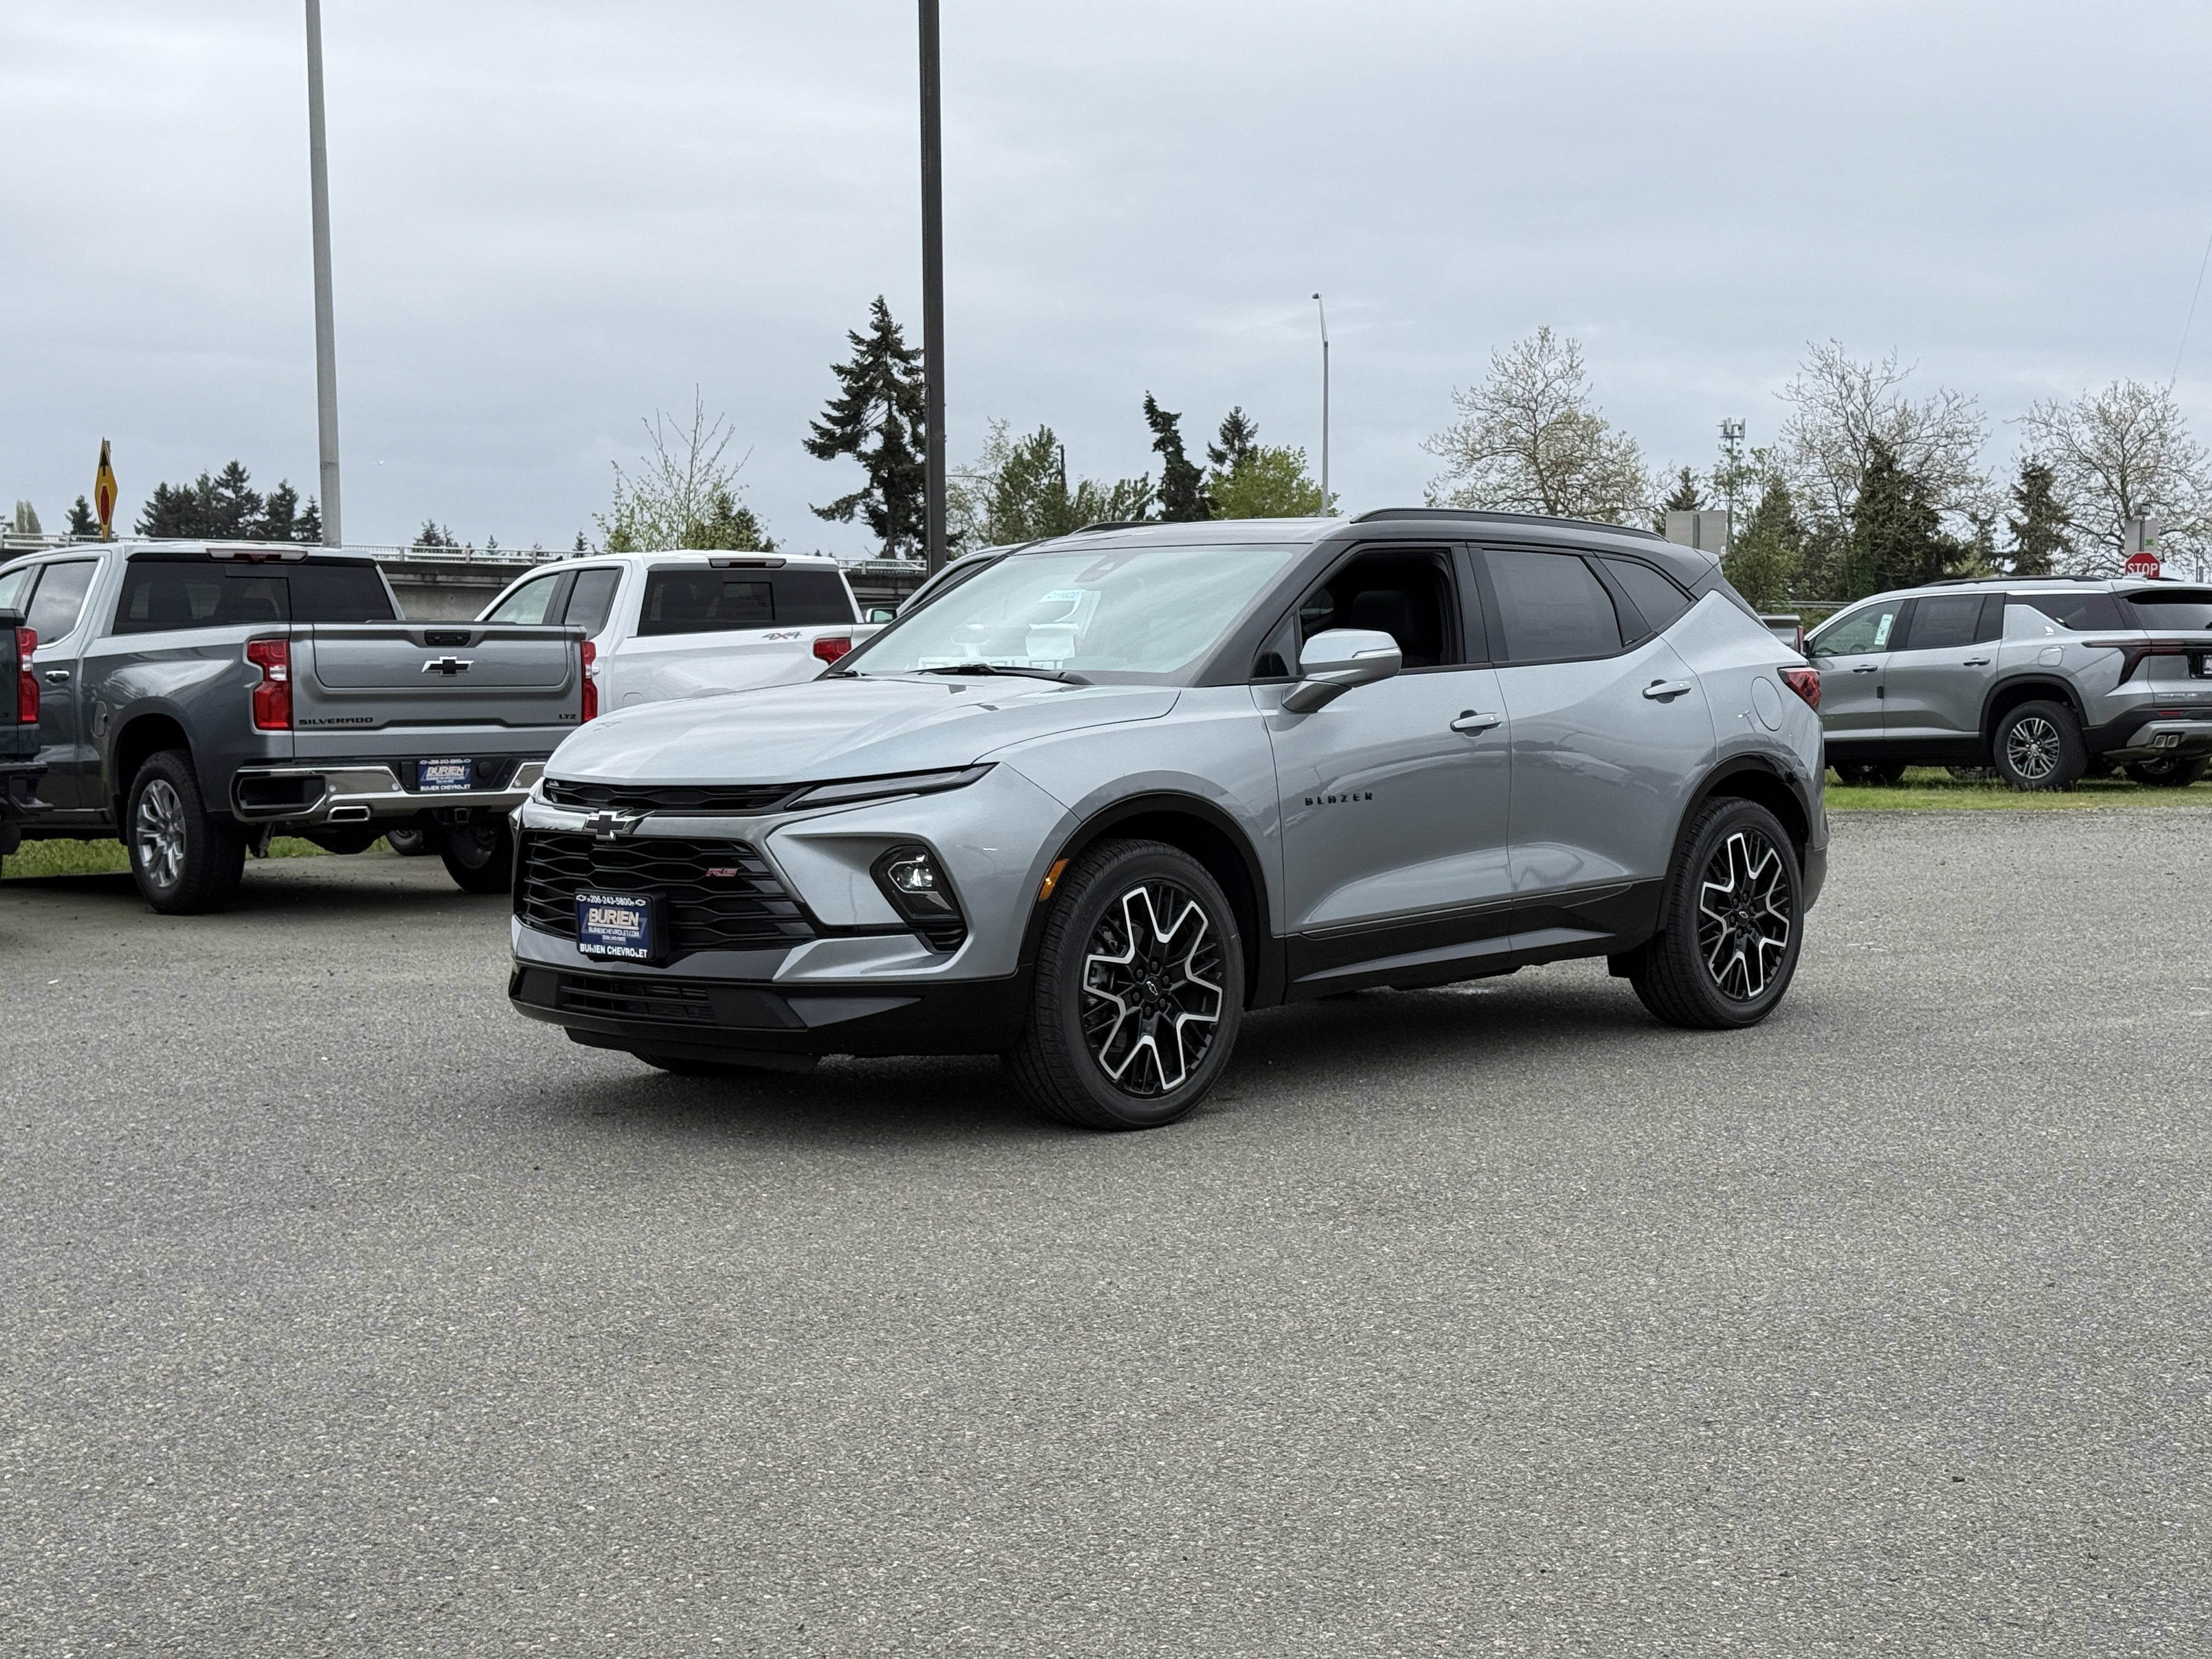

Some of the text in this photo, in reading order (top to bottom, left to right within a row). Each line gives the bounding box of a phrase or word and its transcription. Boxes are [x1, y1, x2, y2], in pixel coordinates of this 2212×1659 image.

[2128, 562, 2158, 575] STOP
[299, 717, 374, 725] SILVERADO
[427, 766, 465, 776] BURIEN
[1305, 792, 1373, 806] BLAZER
[706, 868, 738, 877] RS
[589, 908, 639, 926] BURIEN
